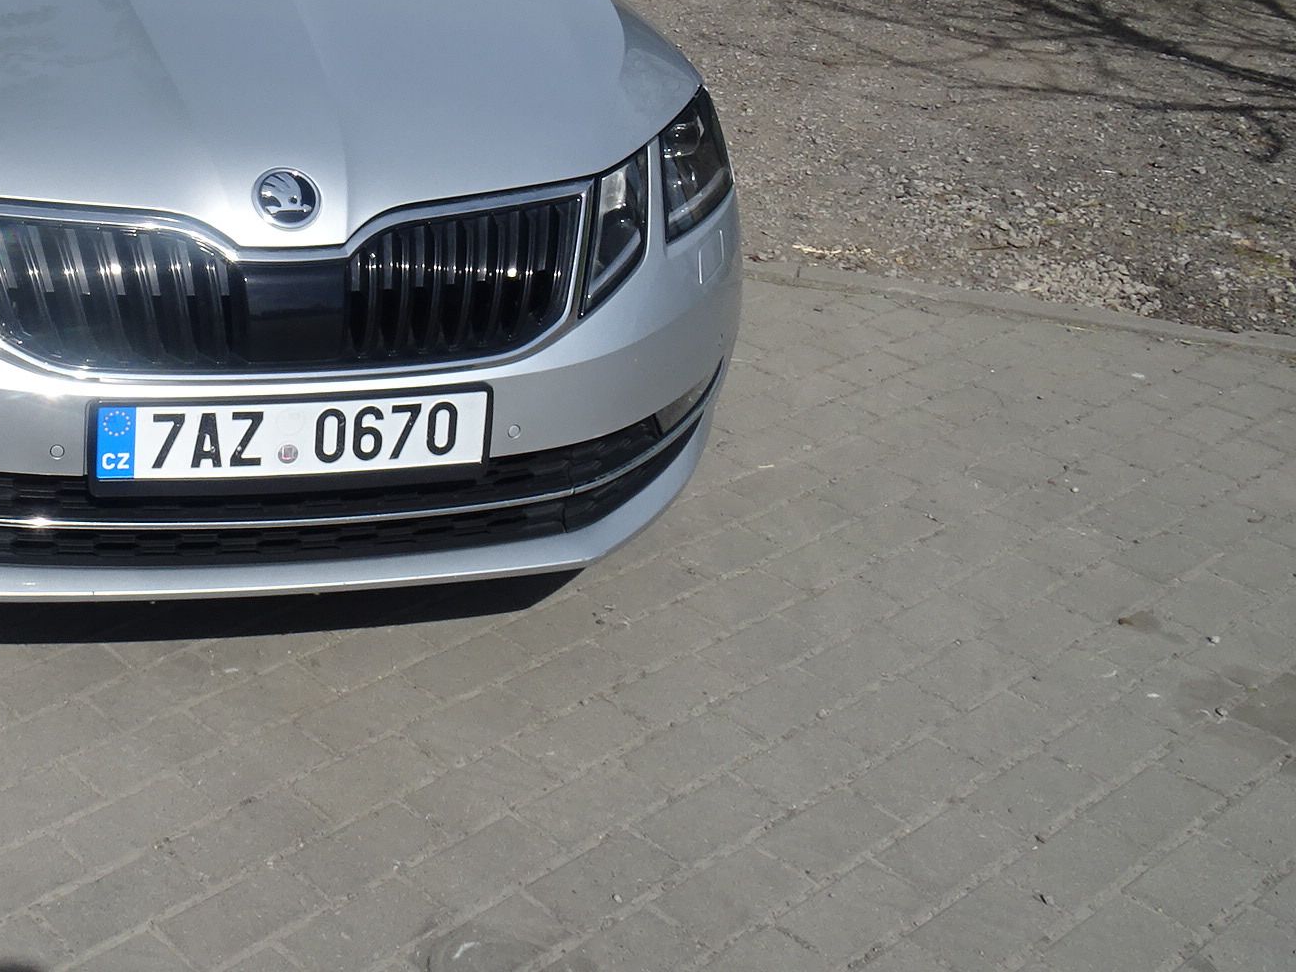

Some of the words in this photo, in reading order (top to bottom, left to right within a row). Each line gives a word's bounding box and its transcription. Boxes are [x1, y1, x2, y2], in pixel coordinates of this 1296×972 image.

[151, 411, 264, 469] 7AZ
[314, 401, 459, 464] 0670
[101, 453, 130, 470] CZ
